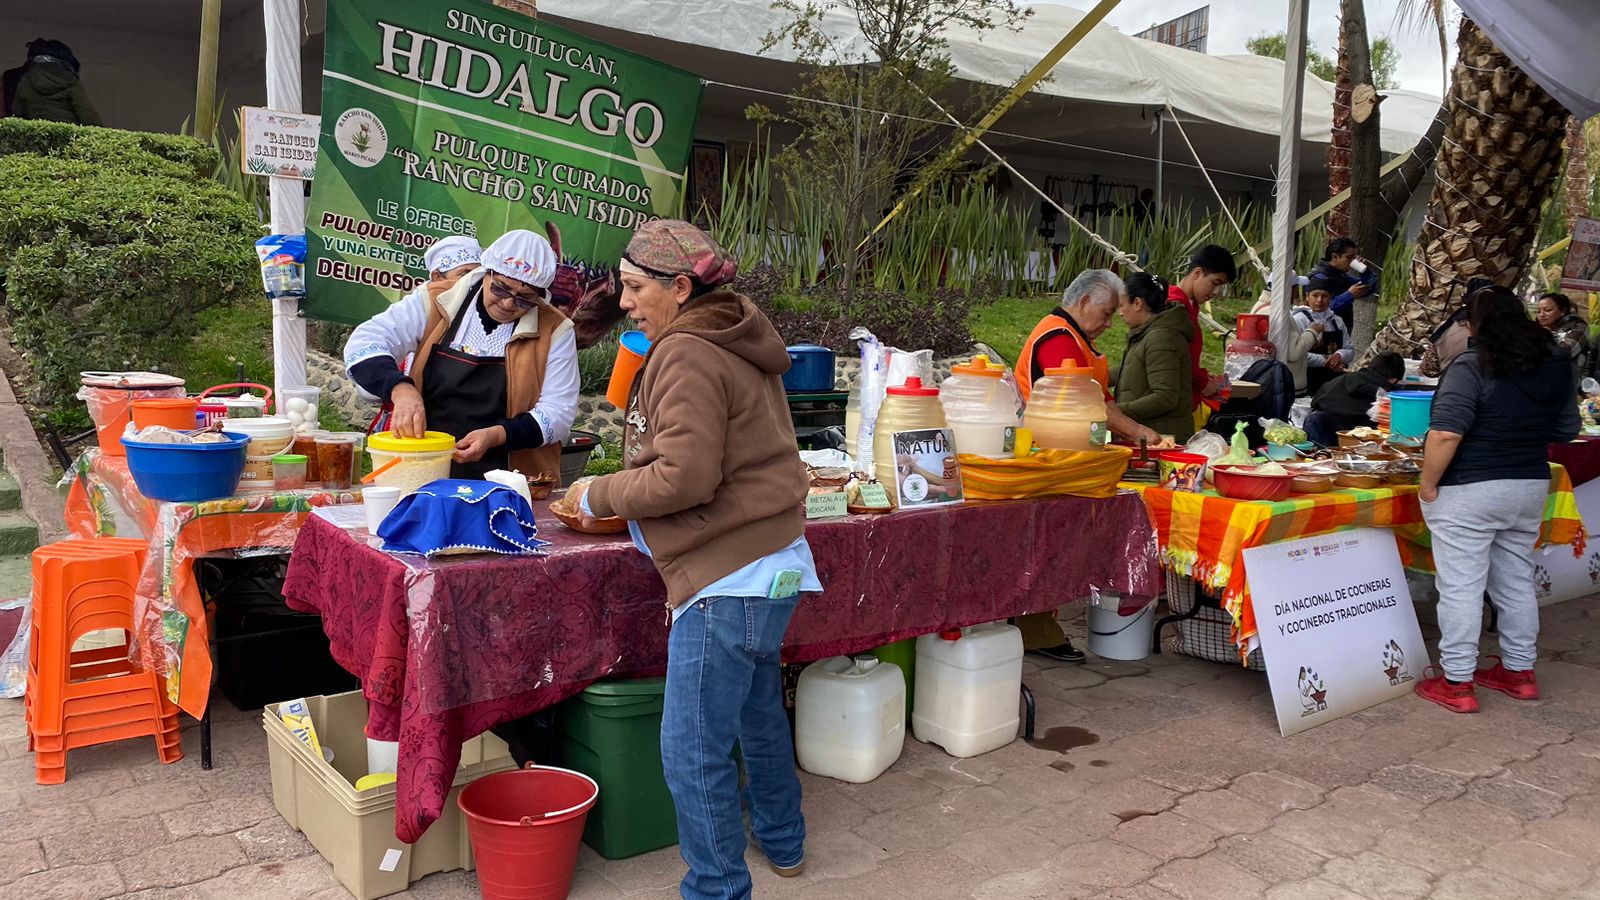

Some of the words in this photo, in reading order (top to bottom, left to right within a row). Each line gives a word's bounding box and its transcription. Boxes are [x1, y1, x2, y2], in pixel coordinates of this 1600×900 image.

[446, 9, 619, 85] SINGUILUCAN,
[375, 21, 664, 149] HIDALGO
[338, 110, 361, 129] RANCHO
[361, 111, 372, 120] SAN
[372, 117, 386, 141] ISIDRO
[255, 145, 278, 158] SAN
[434, 131, 530, 174] PULQUE
[534, 158, 549, 178] Y
[552, 164, 651, 206] CURADOS
[377, 199, 399, 220] LE
[404, 206, 477, 237] OFRECE:
[530, 184, 582, 216] SAN
[320, 212, 394, 242] PULQUE
[323, 236, 336, 251] Y
[336, 238, 367, 257] UNA
[369, 246, 427, 271] EXTENSA
[1274, 601, 1292, 617] DÍA
[1292, 592, 1335, 612] NACIONAL
[1335, 588, 1347, 601] DE
[1348, 577, 1392, 598] COCINERAS
[1278, 624, 1286, 637] Y
[1286, 611, 1335, 635] COCINEROS
[1335, 595, 1398, 622] TRADICIONALES
